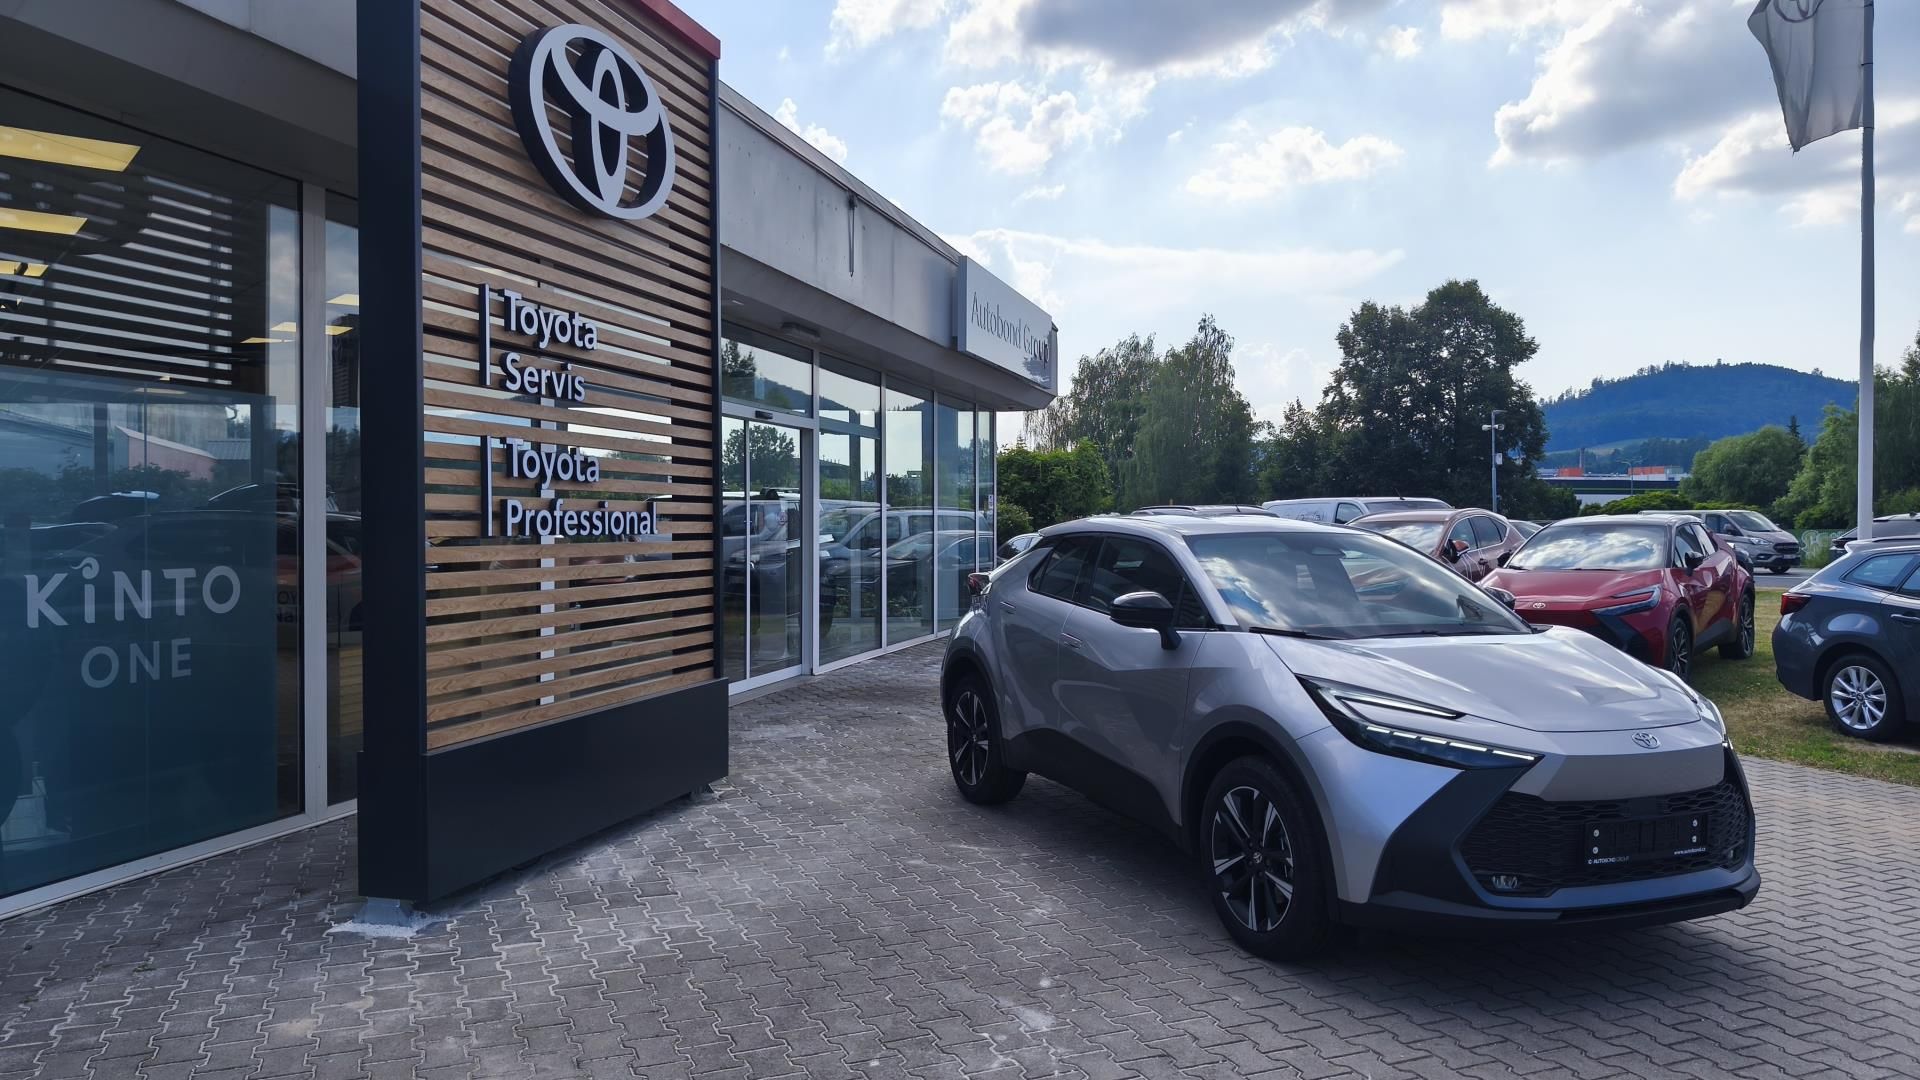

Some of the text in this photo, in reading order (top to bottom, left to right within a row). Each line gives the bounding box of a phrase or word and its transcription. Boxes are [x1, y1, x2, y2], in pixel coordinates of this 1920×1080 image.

[501, 288, 598, 350] Toyota
[971, 291, 1049, 369] Autobond Group
[503, 351, 586, 402] Servis
[503, 437, 600, 490] Toyota
[504, 499, 658, 537] Professional
[80, 637, 192, 689] ONE
